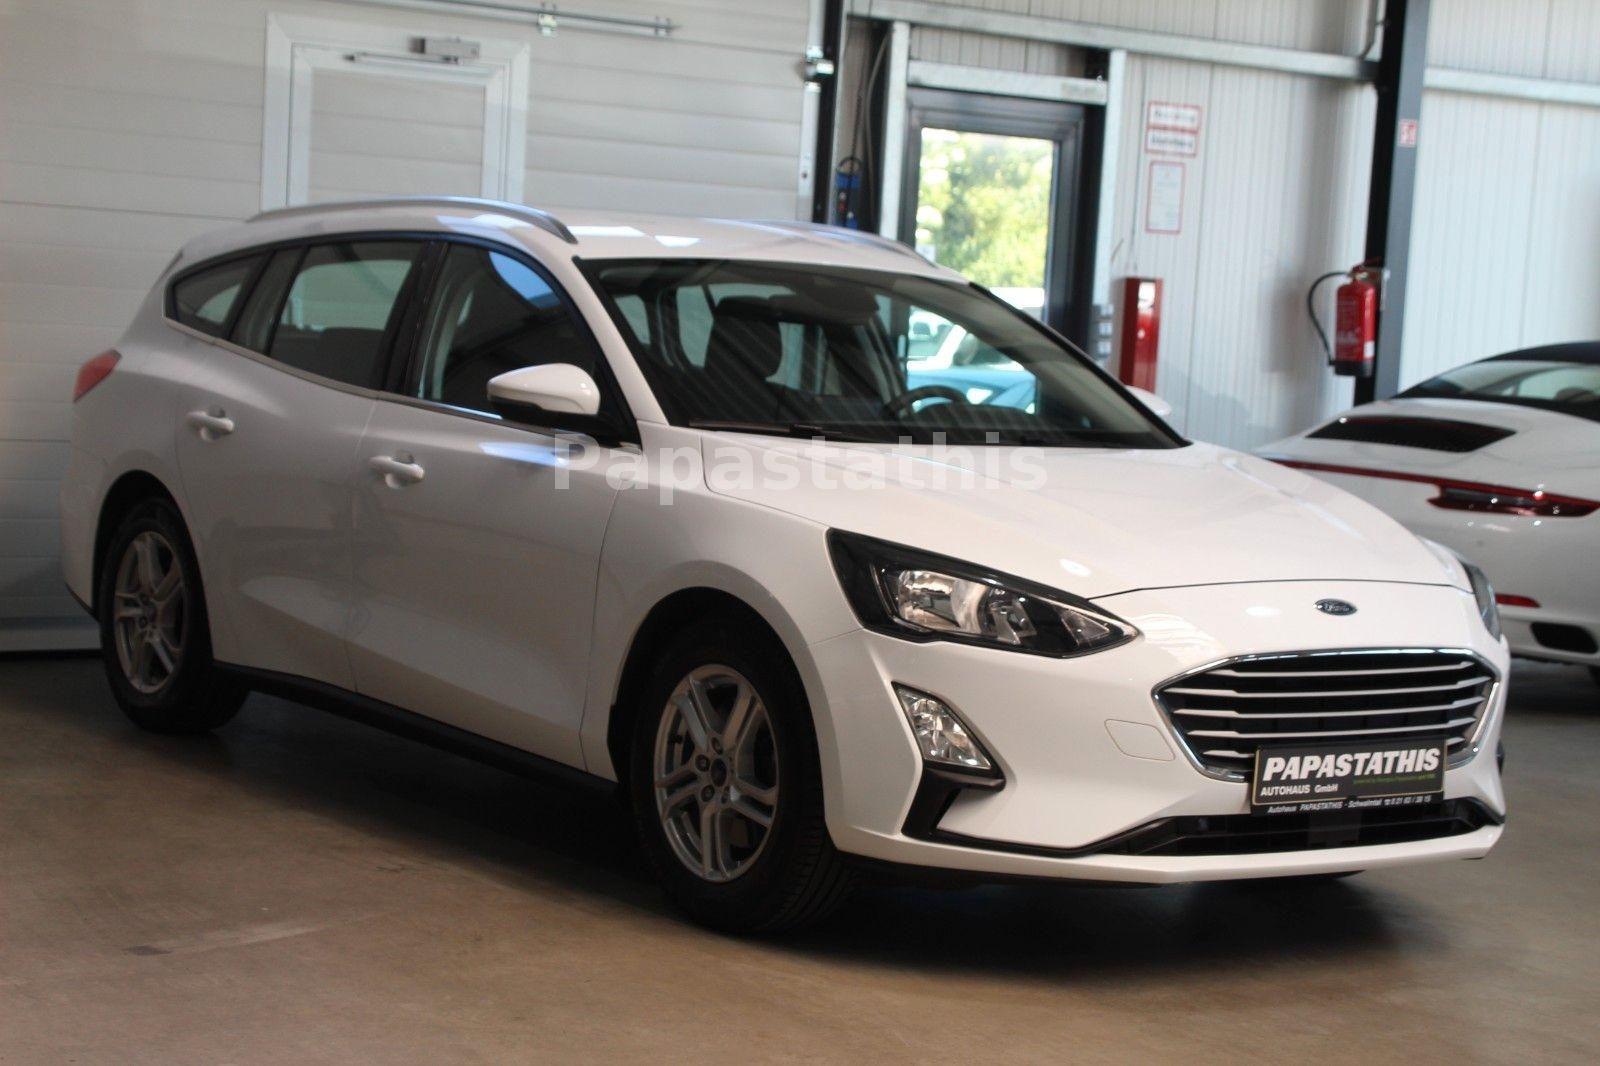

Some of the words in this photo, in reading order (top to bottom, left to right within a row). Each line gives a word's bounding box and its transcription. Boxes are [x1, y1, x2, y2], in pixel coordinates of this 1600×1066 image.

[1262, 747, 1441, 782] PAPASTATHIS
[1260, 784, 1311, 797] AUTOHAUS
[1314, 783, 1339, 794] GmbH
